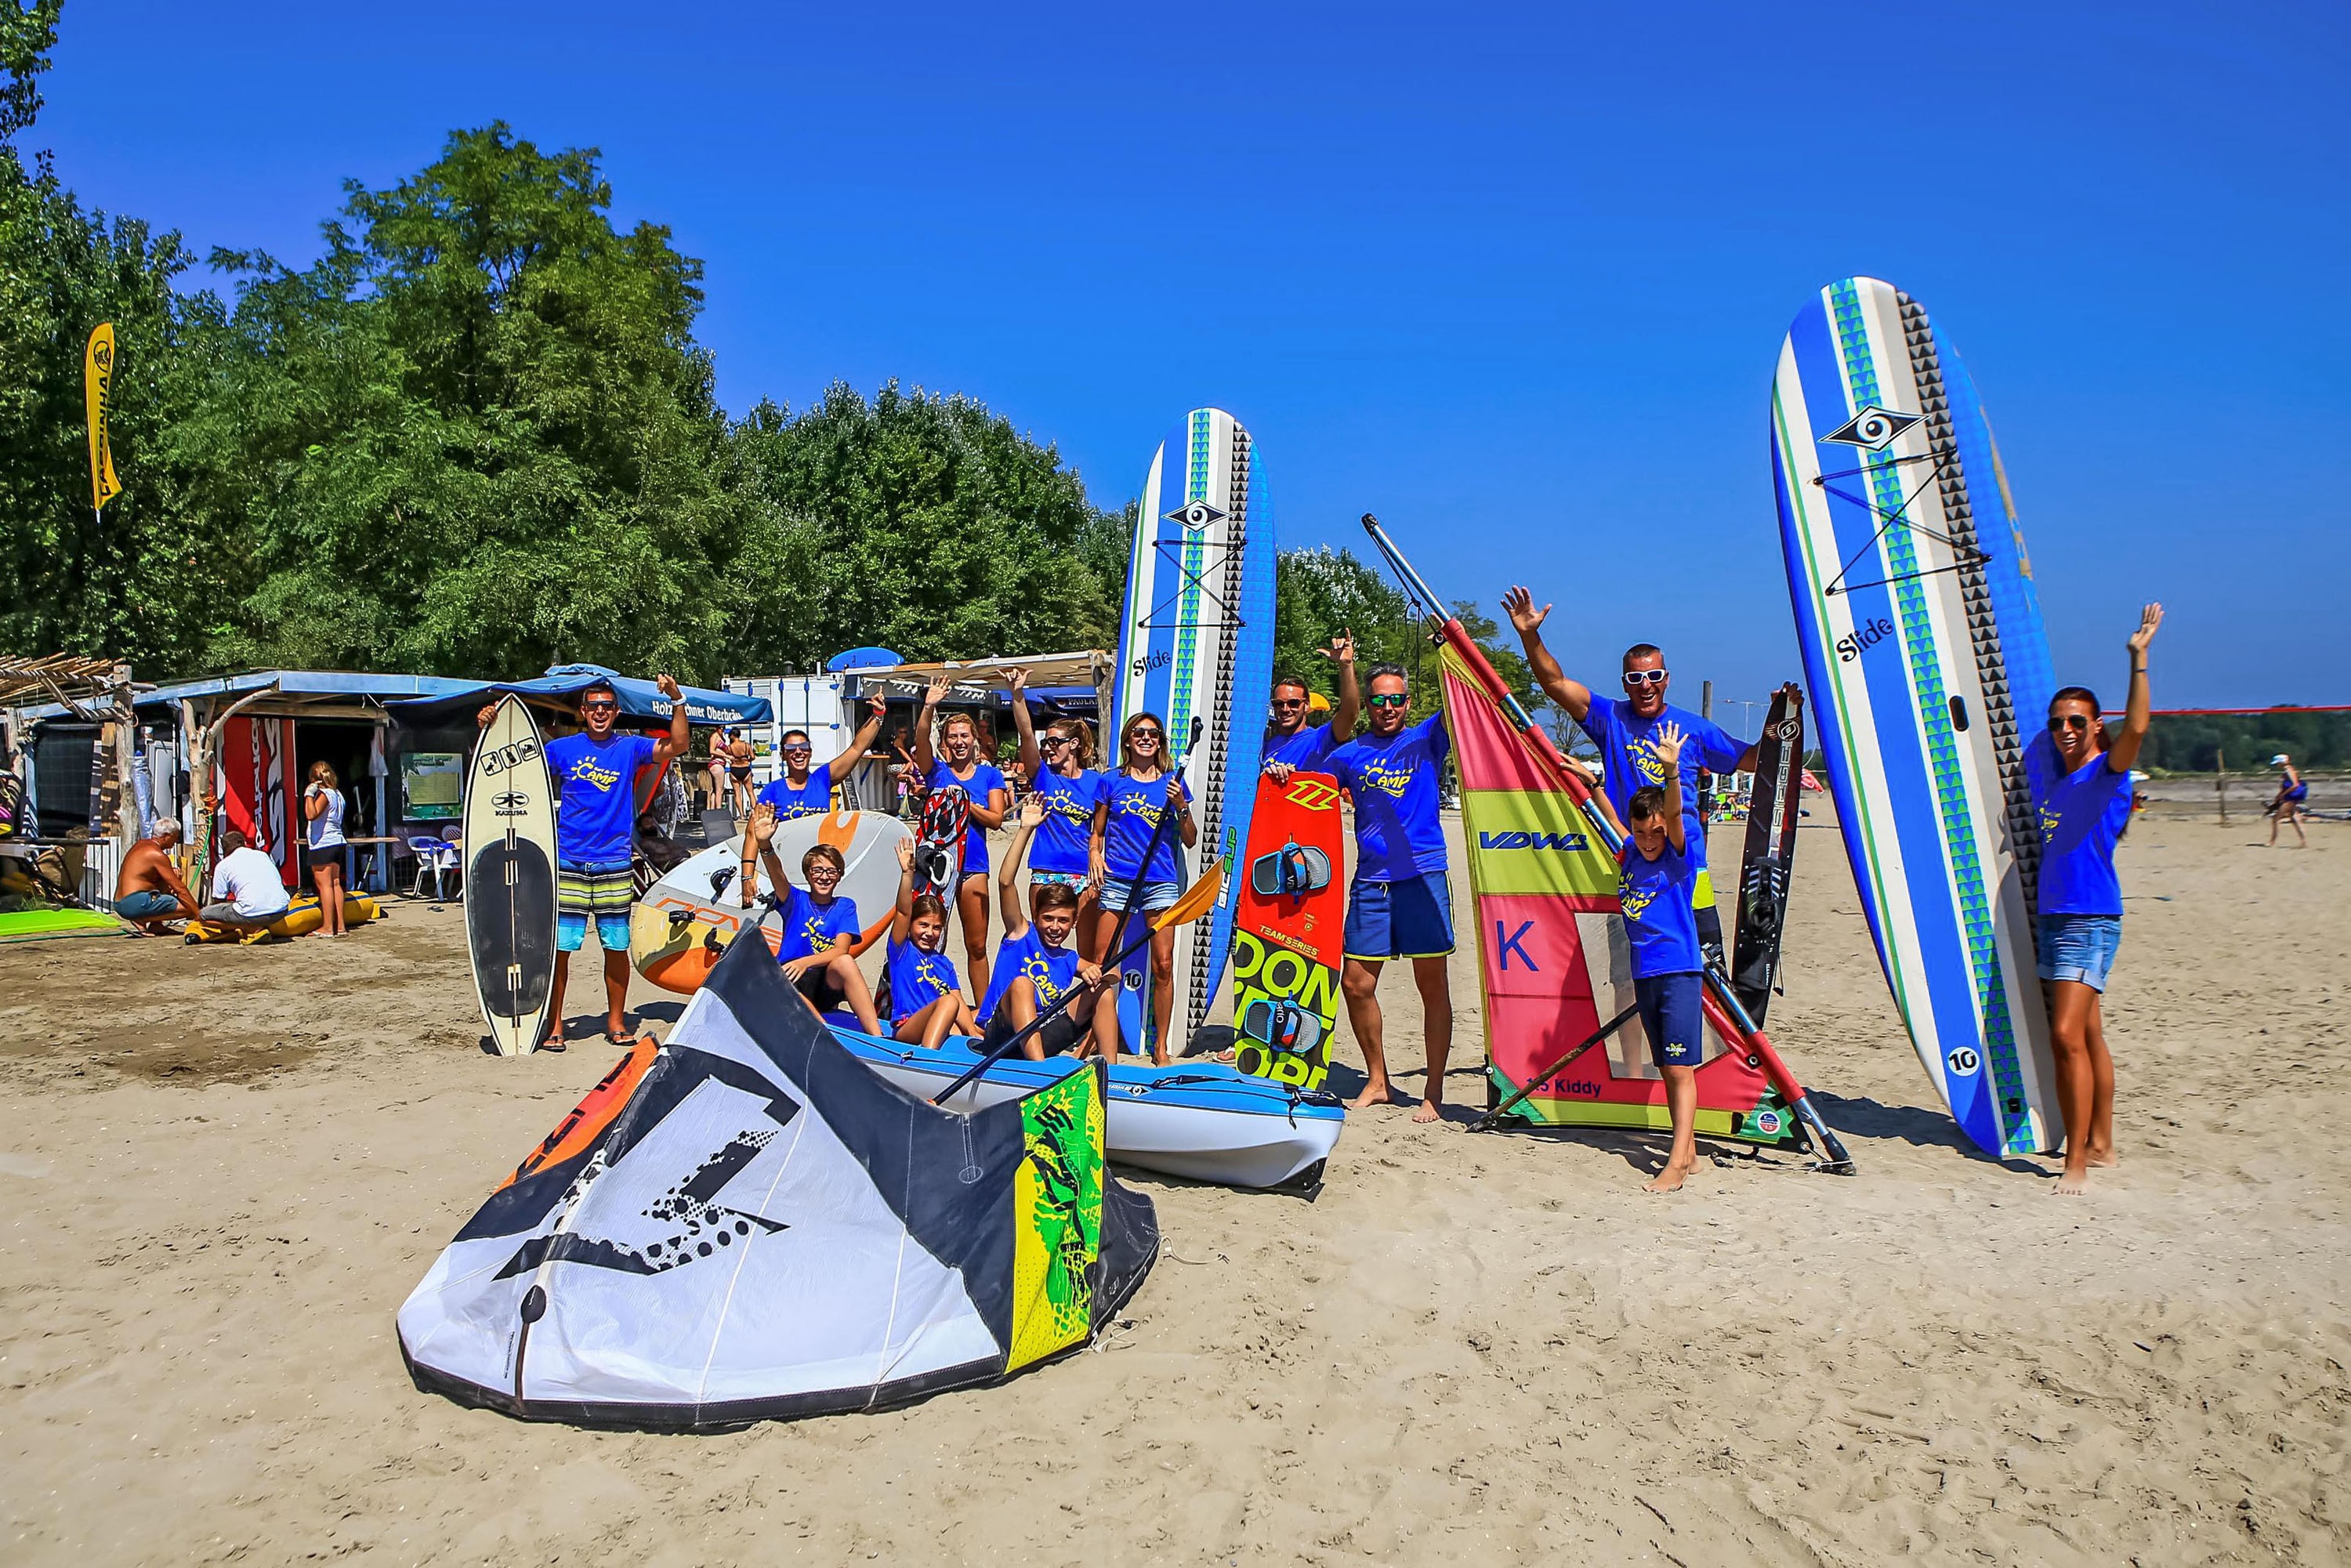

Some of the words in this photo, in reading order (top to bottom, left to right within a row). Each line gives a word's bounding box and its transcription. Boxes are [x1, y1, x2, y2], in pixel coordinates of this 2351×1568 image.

[1836, 618, 1893, 662] Slide
[1133, 650, 1171, 676] Slide
[652, 701, 705, 718] Holzchner
[577, 762, 618, 784] CAMP
[1365, 766, 1411, 788] CAMP
[1773, 746, 1791, 827] SIEGE
[1052, 795, 1090, 820] CAMP
[1126, 798, 1161, 822] CAM
[1479, 831, 1589, 851] VDWS
[1496, 920, 1540, 972] K
[1125, 973, 1142, 987] 10
[1949, 1051, 1976, 1070] 10
[1554, 1079, 1601, 1097] Kiddy
